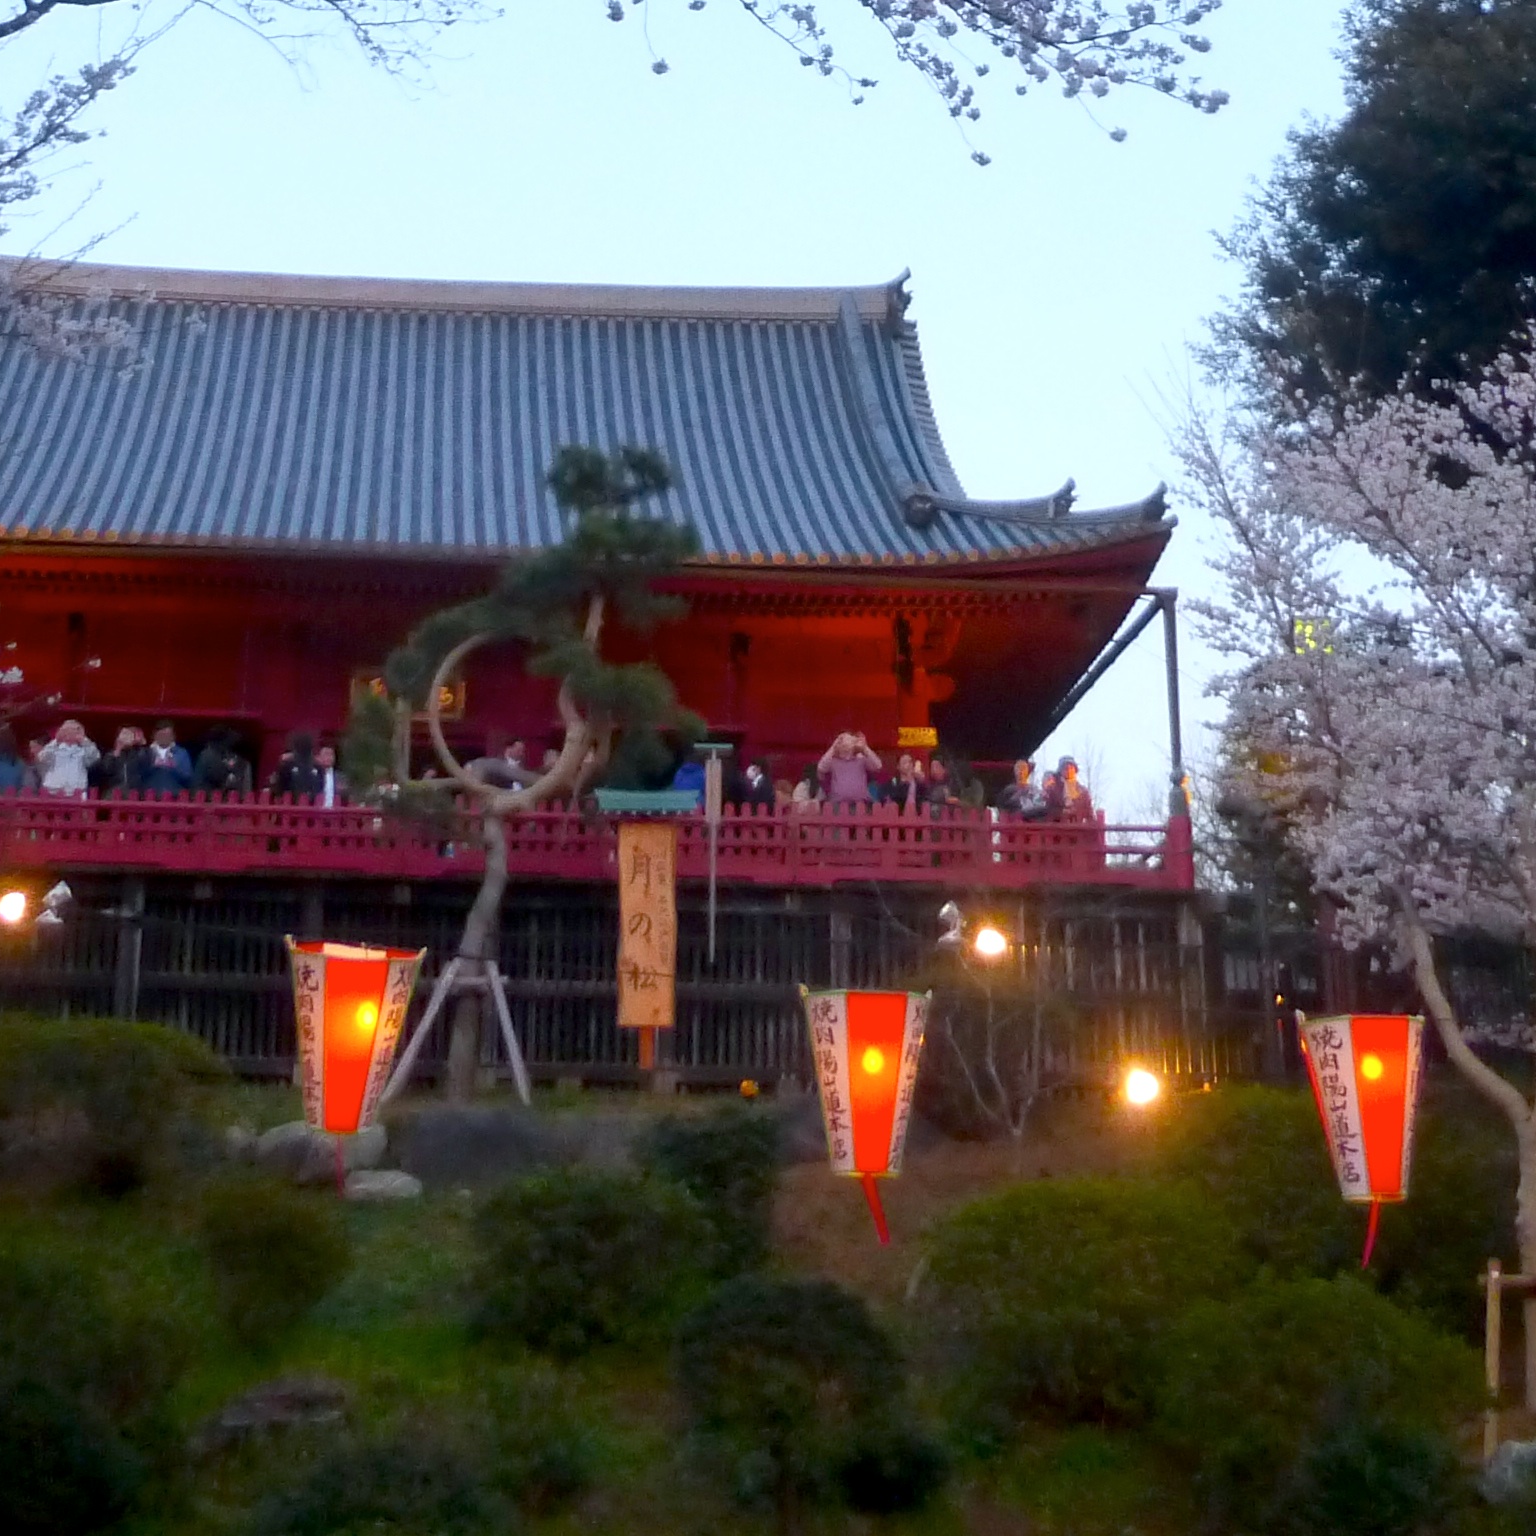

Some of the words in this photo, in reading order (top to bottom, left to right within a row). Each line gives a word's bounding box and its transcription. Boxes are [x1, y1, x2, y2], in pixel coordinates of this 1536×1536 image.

[629, 853, 659, 992] 月の松
[1311, 1026, 1360, 1183] 焼肉陽山道本店
